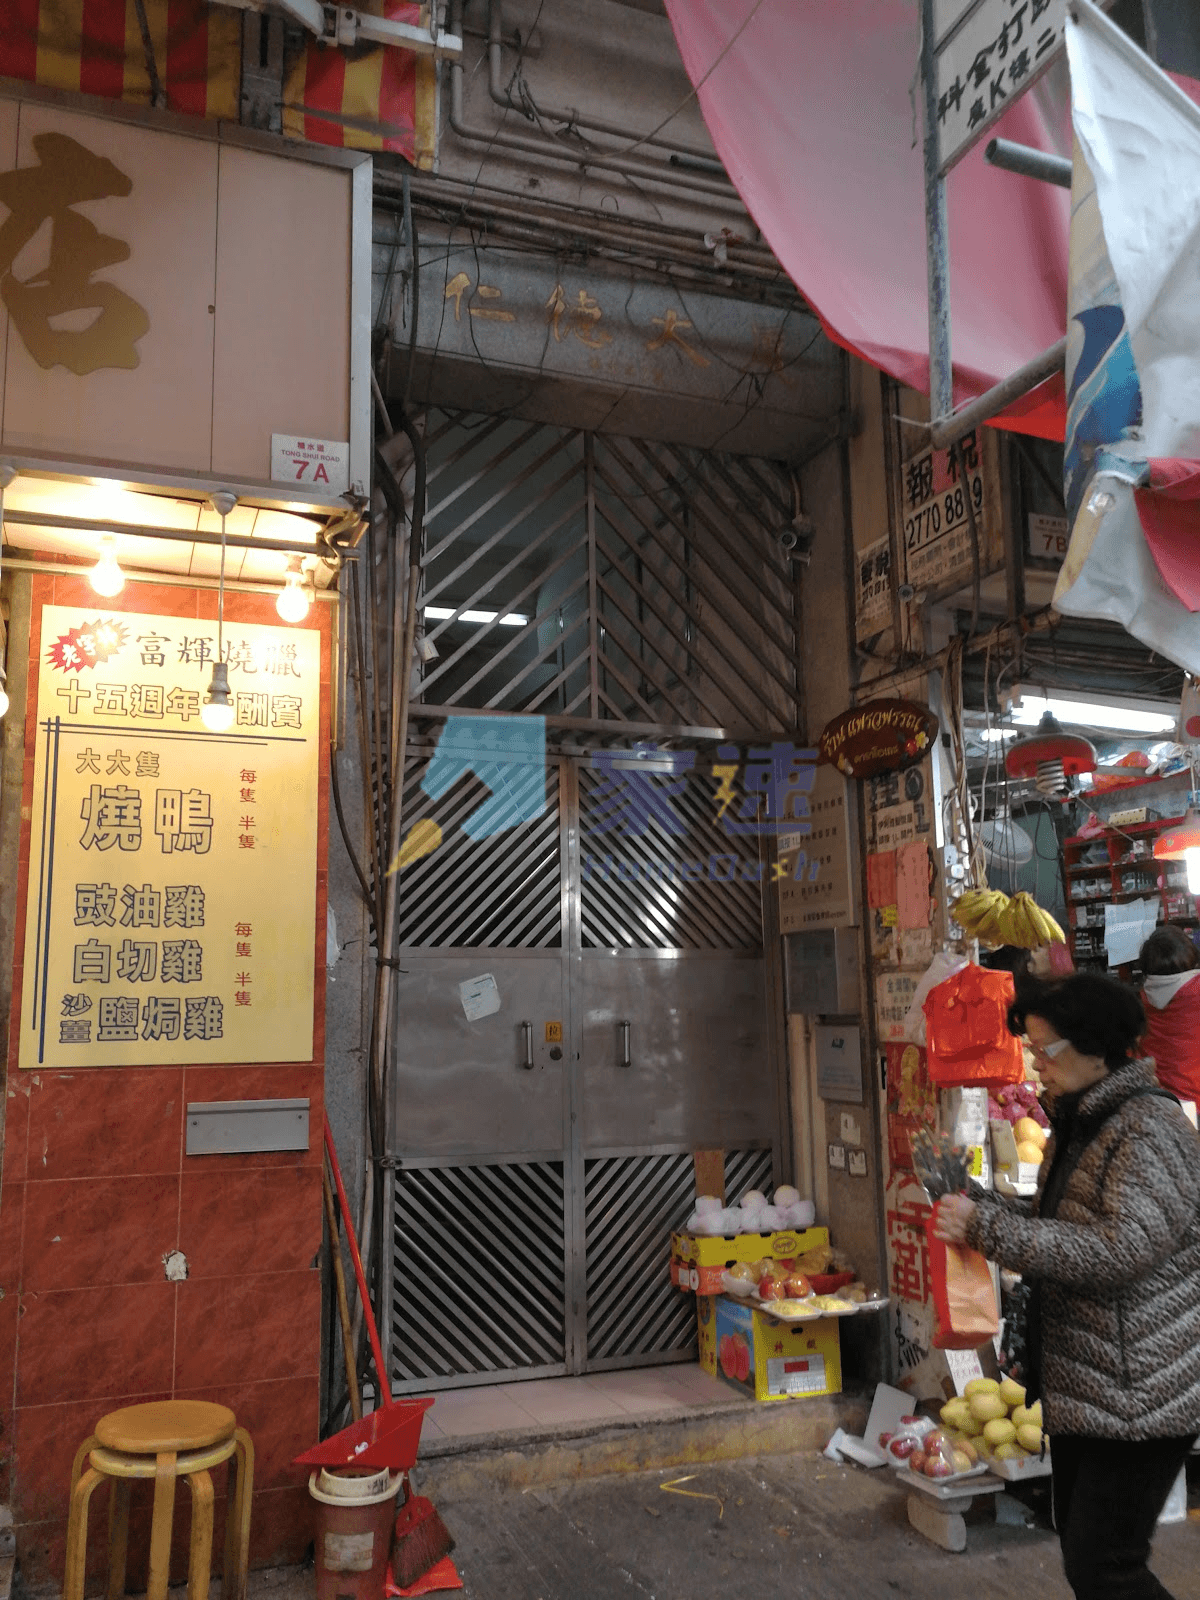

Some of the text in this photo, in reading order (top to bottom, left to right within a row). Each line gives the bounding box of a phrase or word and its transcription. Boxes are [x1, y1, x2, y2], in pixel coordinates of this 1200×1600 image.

[0, 131, 150, 376] 店
[281, 449, 341, 462] TONG SHUI ROAD
[292, 459, 330, 483] 7A
[905, 502, 941, 549] 2770
[944, 476, 983, 525] 889
[56, 678, 303, 730] 十五週年酬賓
[75, 748, 160, 777] 大大隻
[79, 784, 214, 854] 燒鴨
[73, 883, 206, 928] 豉油雞
[73, 938, 203, 984] 白切雞
